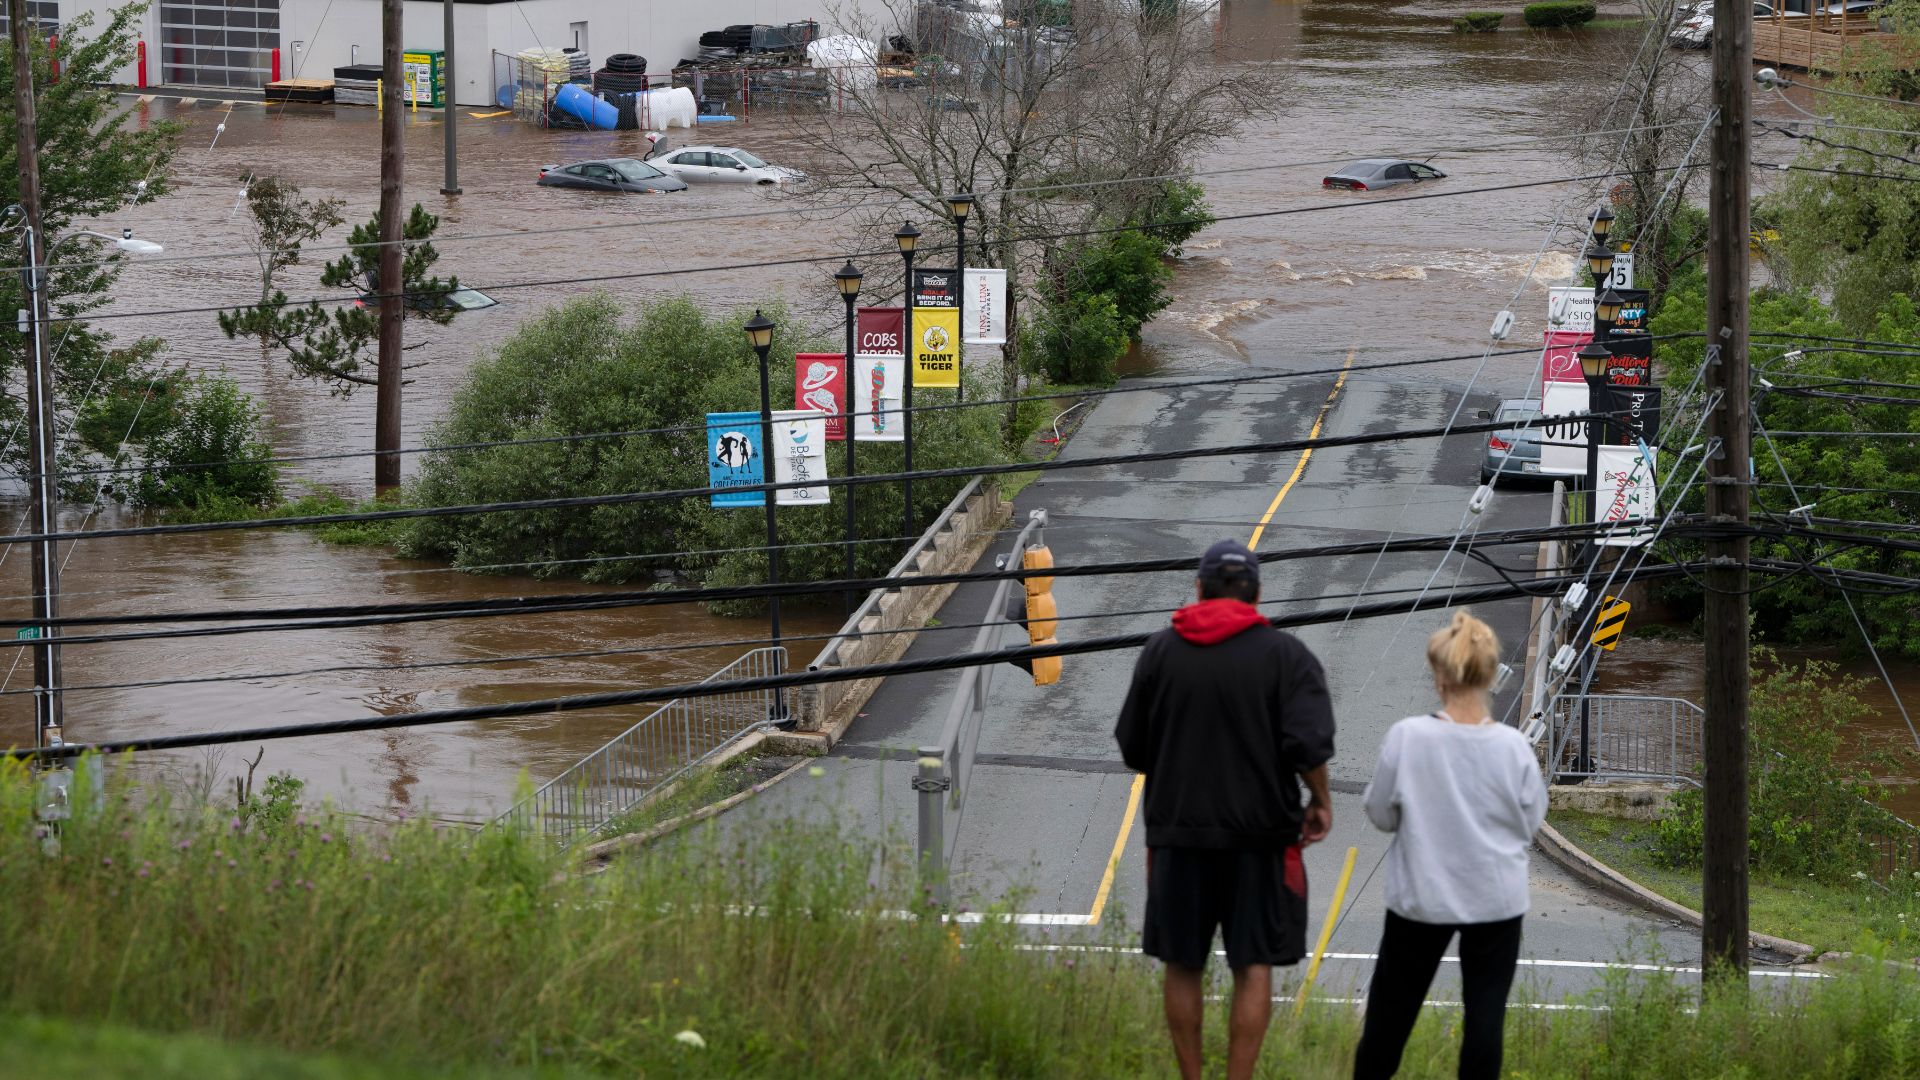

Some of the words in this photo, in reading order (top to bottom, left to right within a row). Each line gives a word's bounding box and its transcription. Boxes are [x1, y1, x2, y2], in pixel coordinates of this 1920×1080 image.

[1567, 311, 1592, 321] YSIO
[863, 332, 898, 348] COBS
[919, 353, 953, 362] GIANT
[1607, 354, 1649, 369] Bedford
[919, 362, 953, 371] TIGER
[713, 478, 762, 489] COLLECTIBLES
